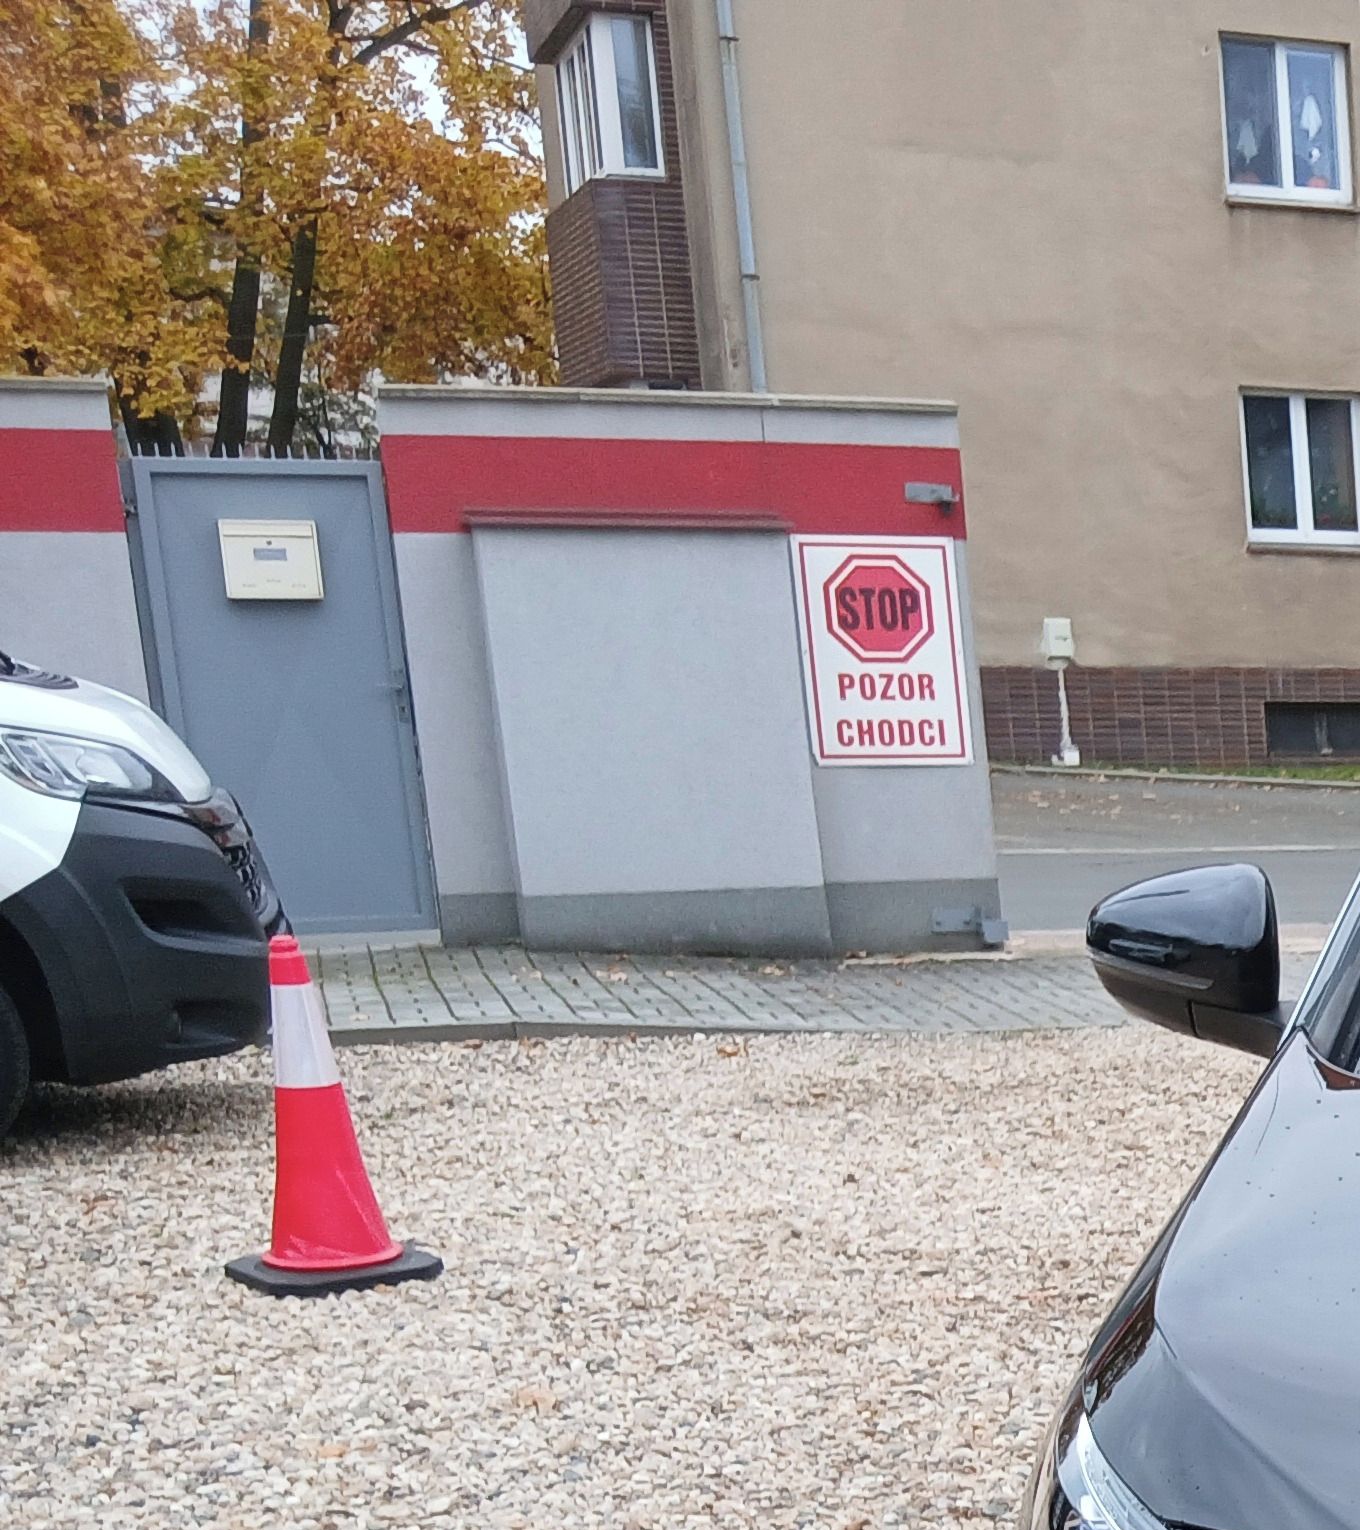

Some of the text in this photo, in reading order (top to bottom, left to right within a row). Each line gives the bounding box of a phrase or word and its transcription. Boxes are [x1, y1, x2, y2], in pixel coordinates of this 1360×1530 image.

[837, 586, 921, 632] STOP
[837, 673, 937, 701] POZOR
[836, 719, 947, 747] CHODCI
